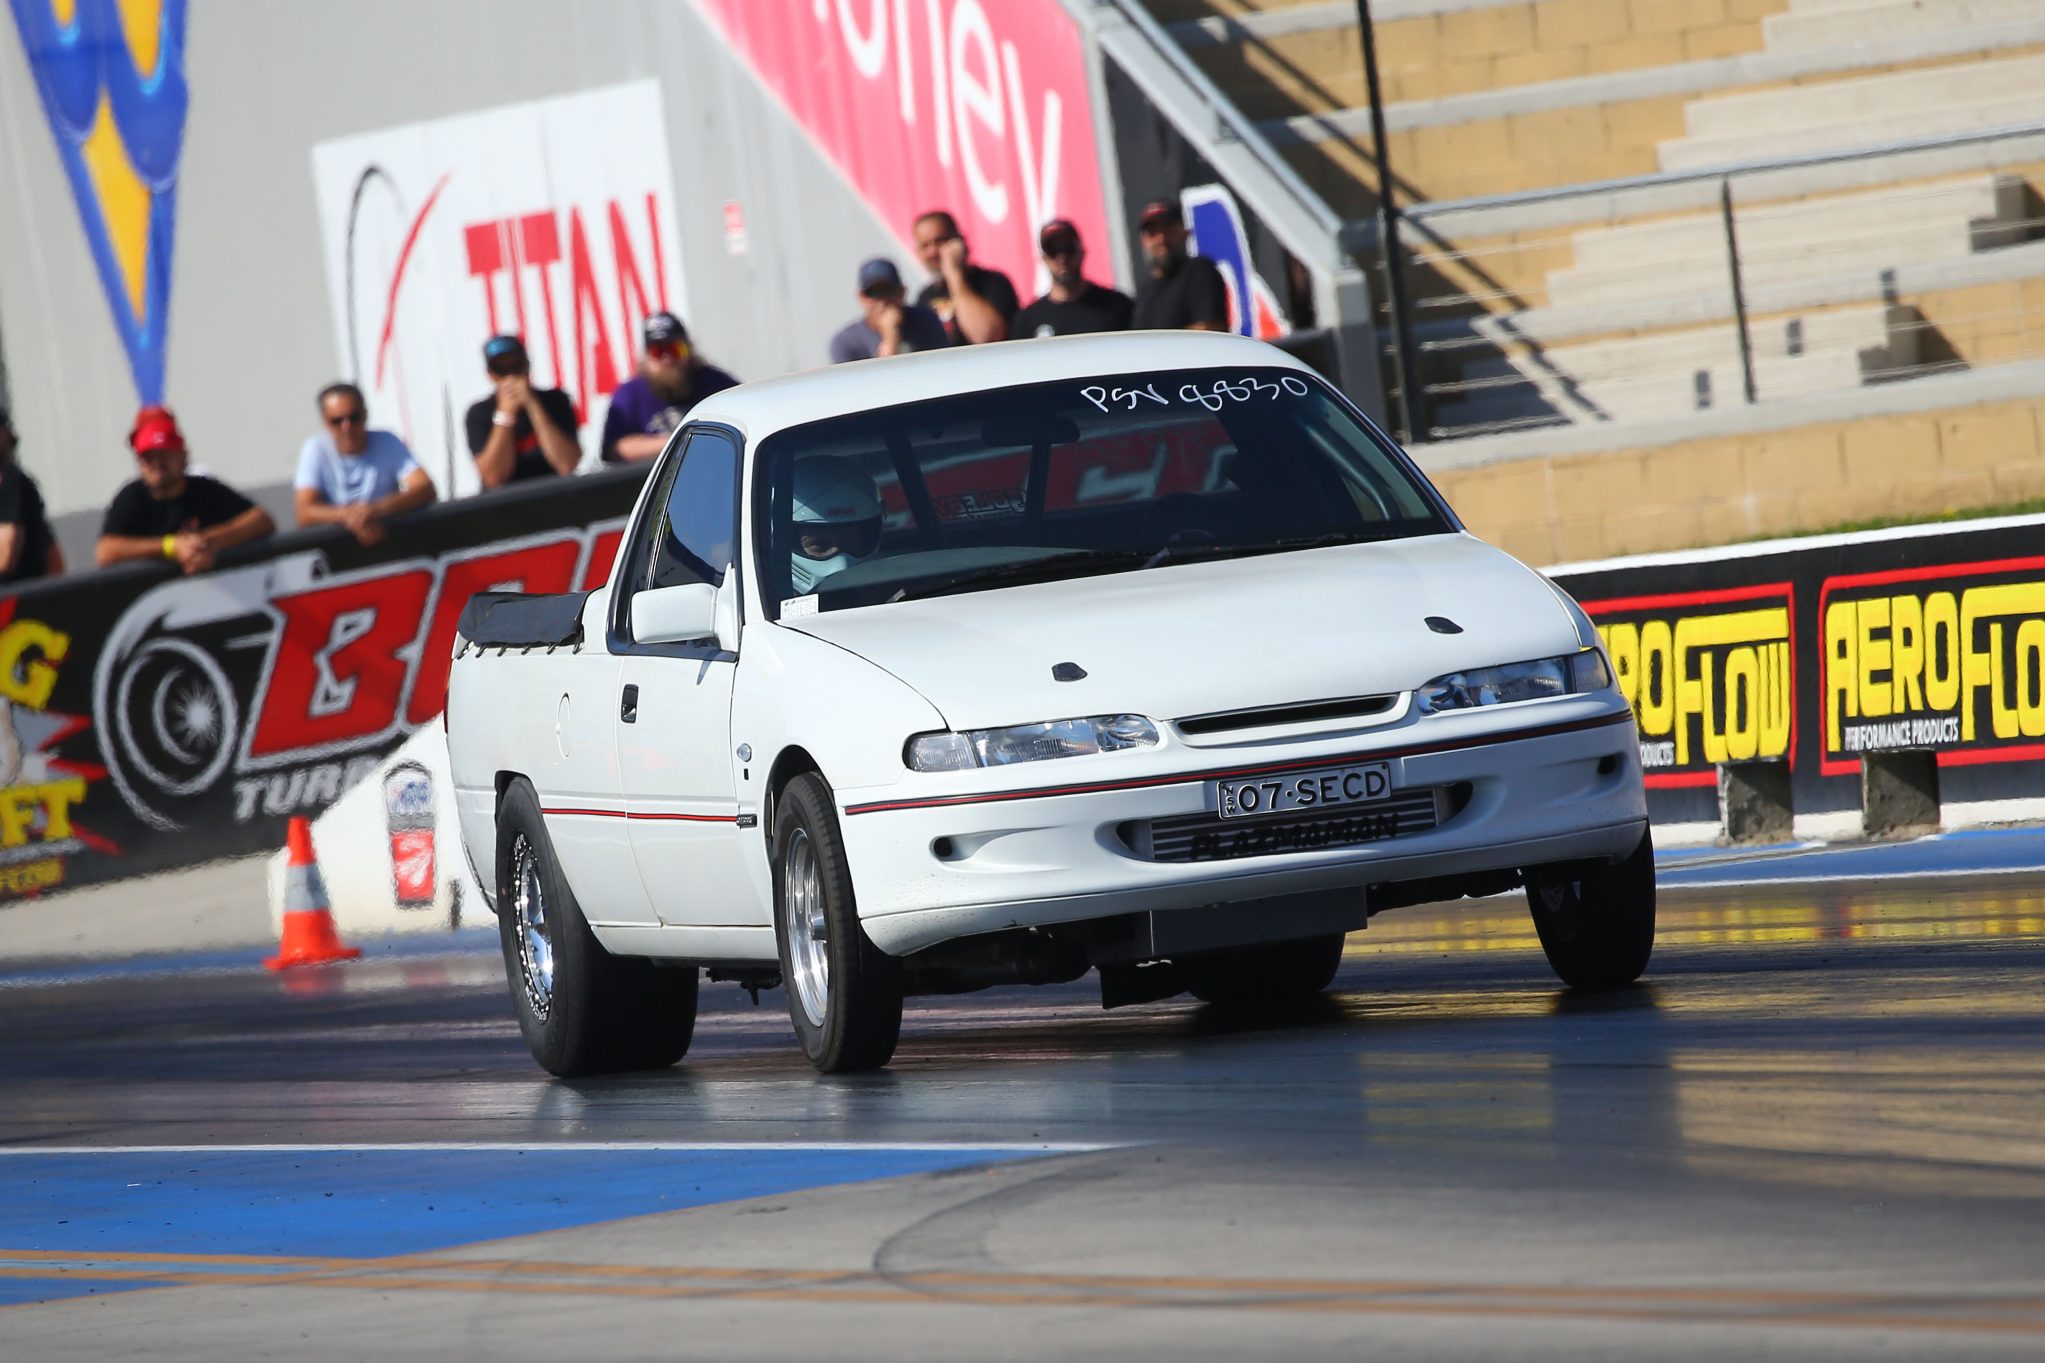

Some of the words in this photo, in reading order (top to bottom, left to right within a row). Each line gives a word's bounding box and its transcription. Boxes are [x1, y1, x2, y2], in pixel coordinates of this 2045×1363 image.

[463, 191, 672, 426] TITAN
[1845, 720, 1911, 751] PERFORMANCE
[1911, 716, 1959, 744] PRODUCTS
[1224, 785, 1236, 815] NSW
